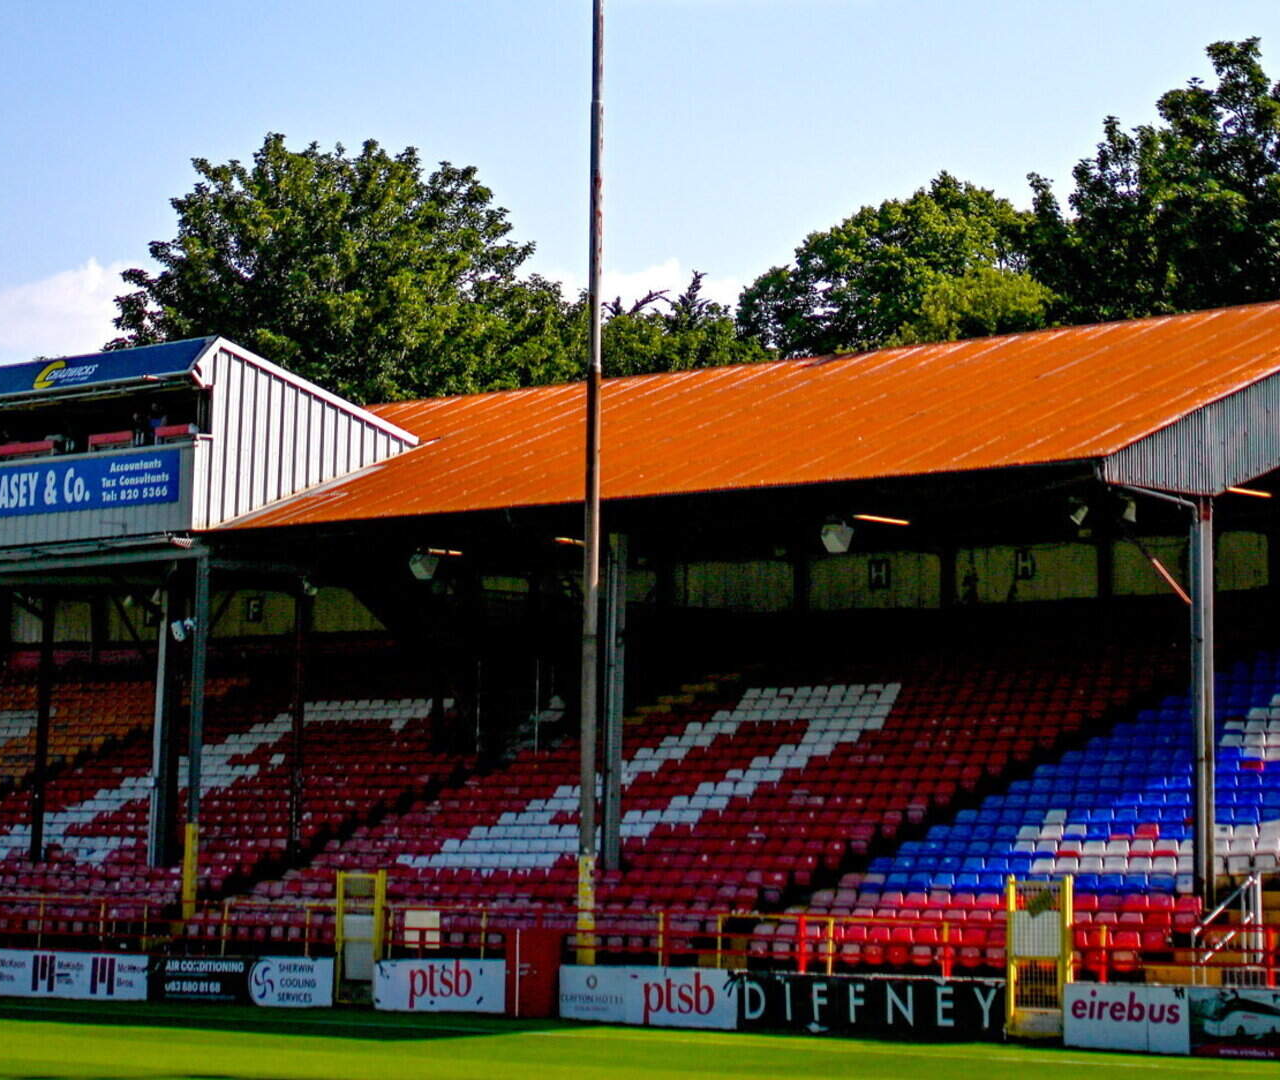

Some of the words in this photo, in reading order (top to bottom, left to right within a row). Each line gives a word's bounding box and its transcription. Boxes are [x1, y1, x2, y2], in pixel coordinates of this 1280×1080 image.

[109, 458, 163, 474] Accountants
[44, 470, 57, 504] &
[64, 468, 90, 503] Co.
[101, 477, 117, 488] Tax
[119, 472, 170, 487] Consultants
[120, 488, 139, 500] 820
[142, 486, 168, 498] 5366
[165, 961, 179, 972] AIR
[180, 961, 244, 973] CONDITIONING
[280, 977, 317, 989] COOLING
[409, 960, 472, 1009] ptsb
[277, 991, 312, 1003] SERVICES
[643, 972, 715, 1024] ptsb
[744, 979, 999, 1030] DIFFNEY
[1072, 989, 1181, 1025] eirebus
